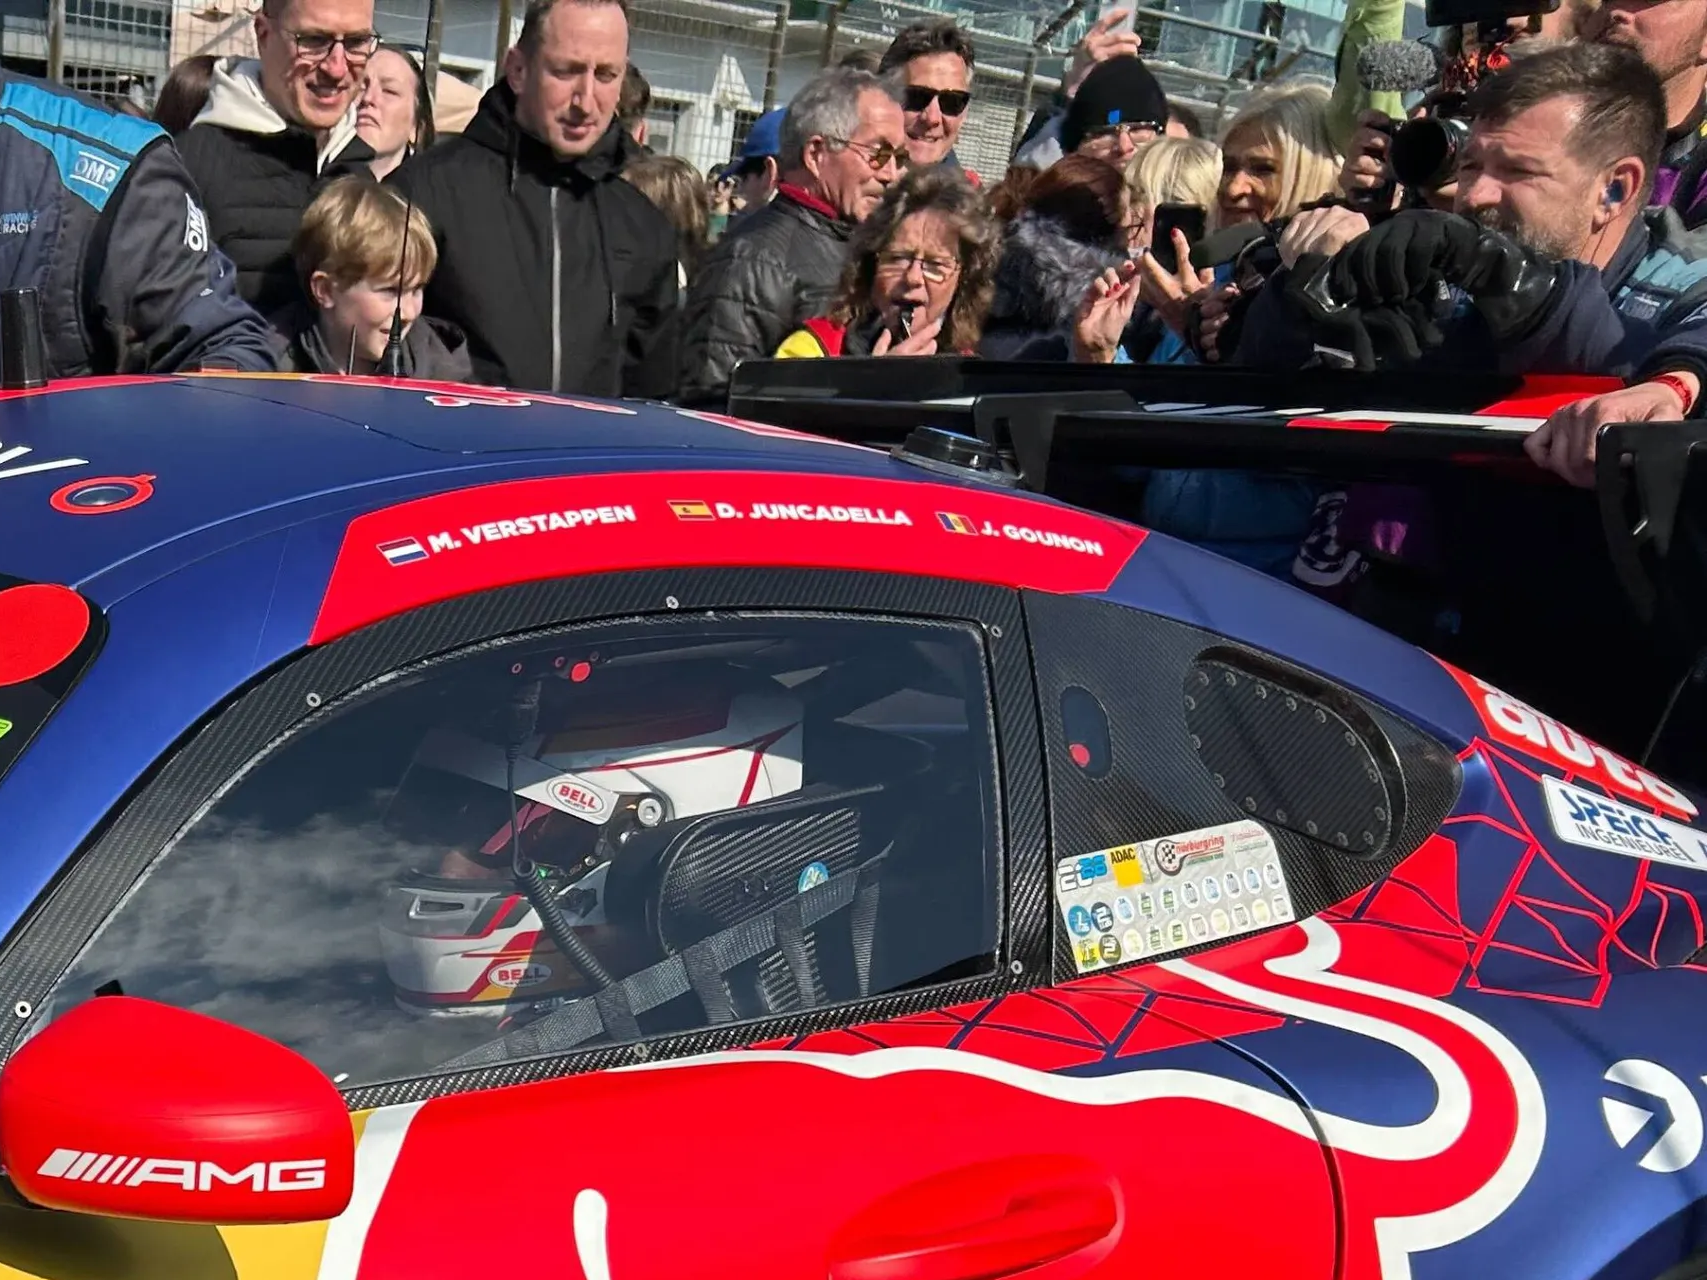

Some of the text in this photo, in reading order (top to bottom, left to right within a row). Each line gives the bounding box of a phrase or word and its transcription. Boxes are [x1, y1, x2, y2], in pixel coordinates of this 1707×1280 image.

[74, 158, 117, 185] OMP
[717, 501, 913, 528] D. JUNCADELLA
[430, 504, 637, 554] M. VERSTAPPEN
[979, 521, 1104, 558] J. GOUNON
[559, 785, 597, 809] BELL
[1110, 847, 1136, 864] ADAC
[498, 967, 547, 982] BELL
[124, 1157, 326, 1192] AMG
